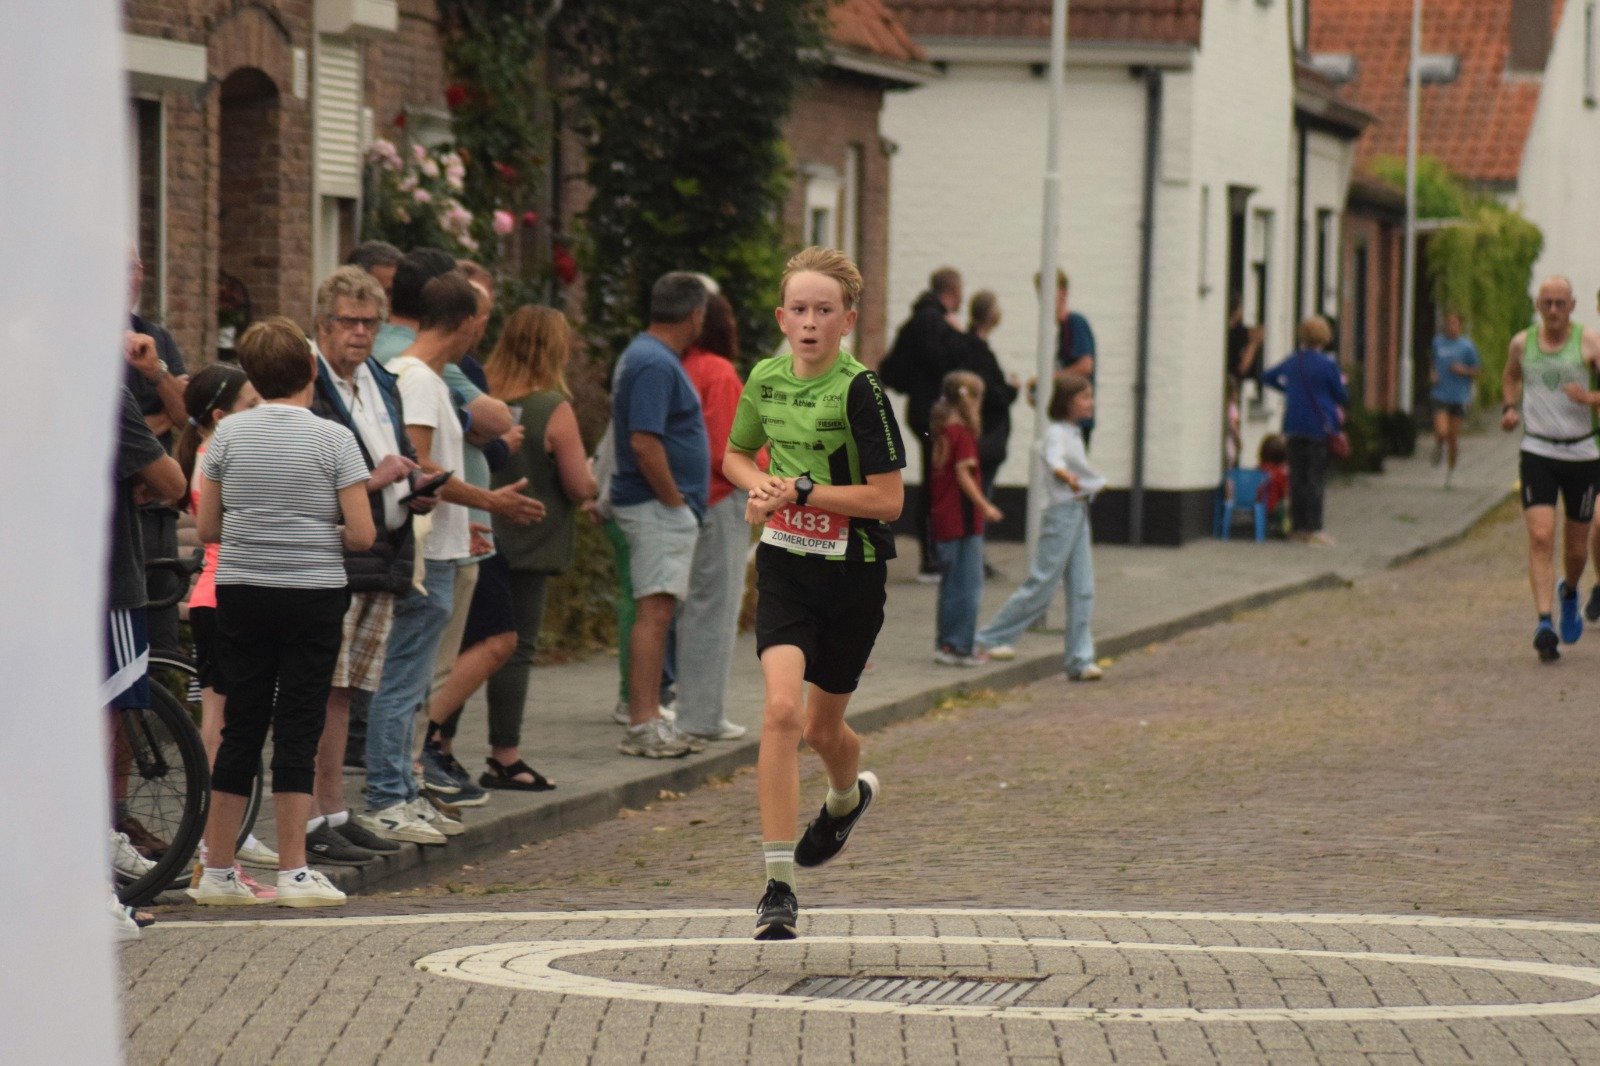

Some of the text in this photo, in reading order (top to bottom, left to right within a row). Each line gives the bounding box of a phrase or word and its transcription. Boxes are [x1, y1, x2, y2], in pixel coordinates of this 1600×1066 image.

[866, 373, 897, 461] LUCKY RUNNERS
[783, 508, 831, 534] 1433
[771, 531, 836, 550] ZOMERLOPEN
